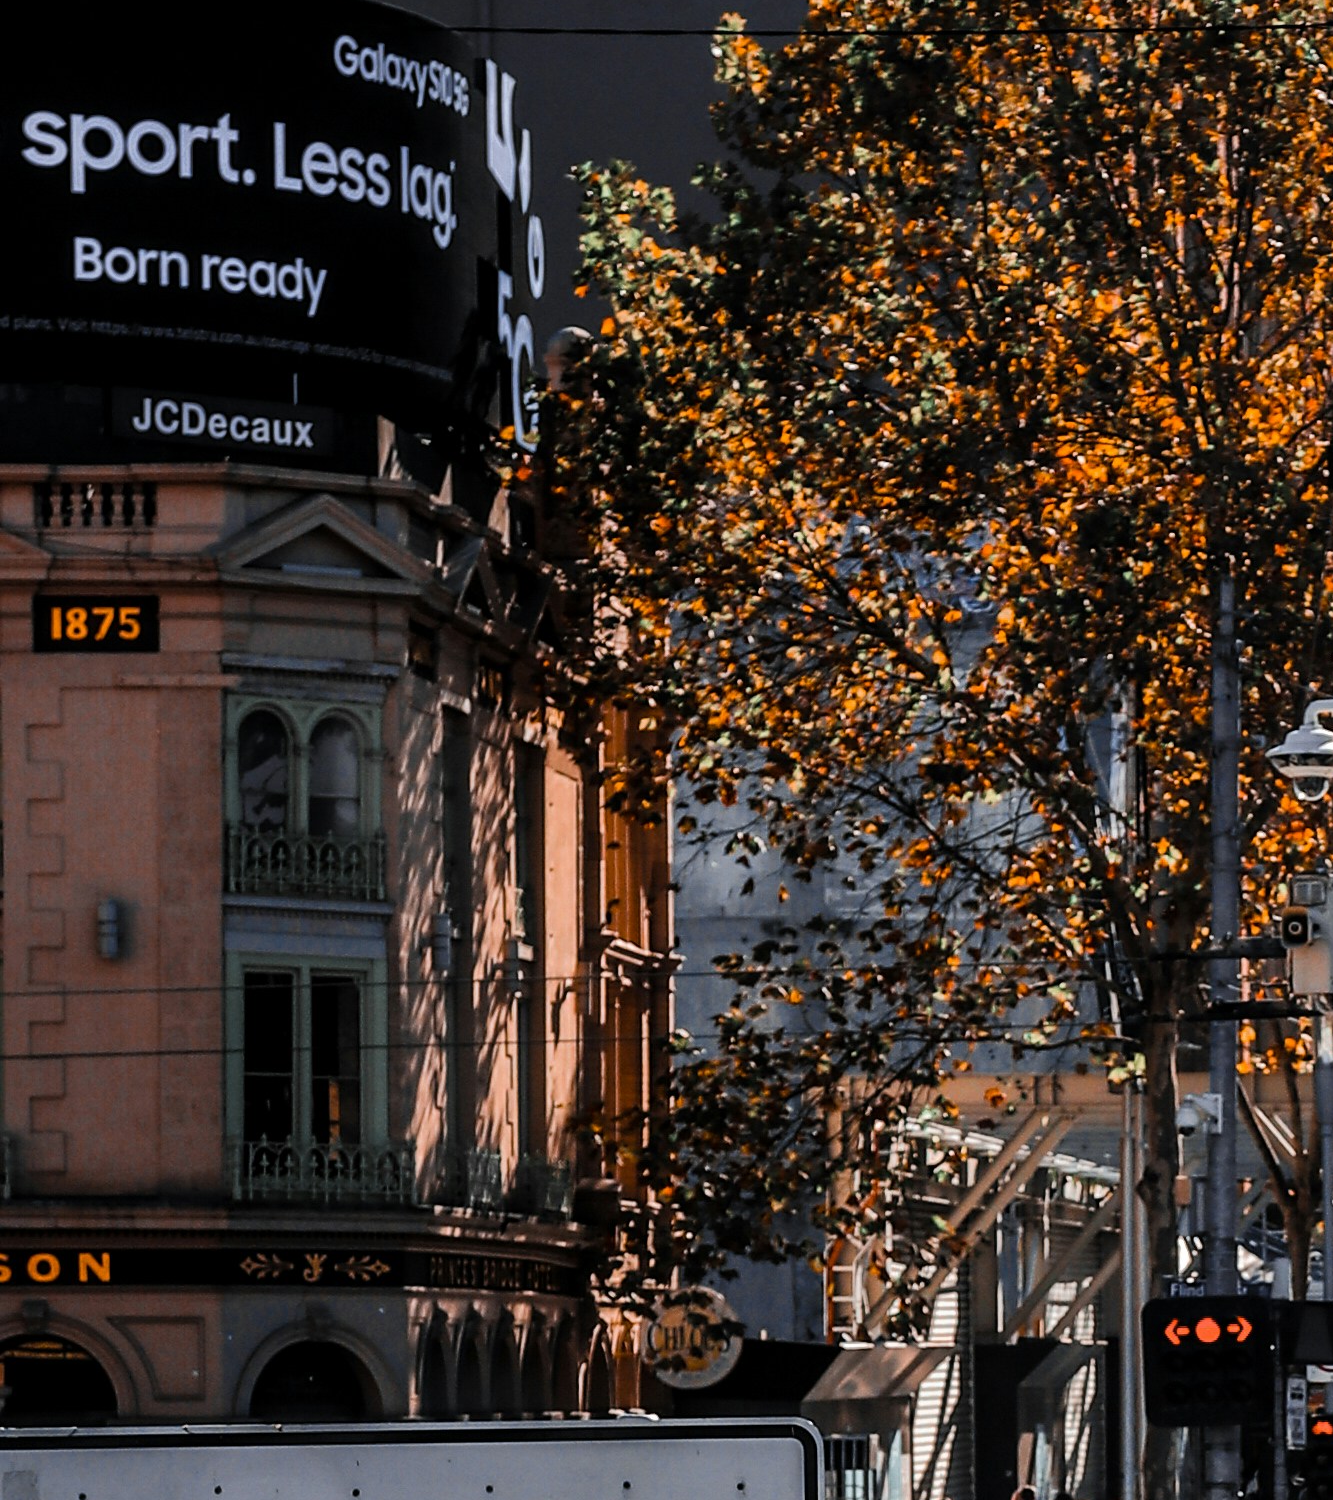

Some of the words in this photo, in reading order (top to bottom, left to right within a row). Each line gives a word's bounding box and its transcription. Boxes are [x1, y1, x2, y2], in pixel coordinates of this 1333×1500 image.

[334, 35, 430, 109] Galaxy
[21, 110, 257, 194] sport.
[273, 121, 392, 208] Less
[73, 237, 190, 289] Born
[202, 252, 328, 318] ready
[132, 398, 314, 449] JCDecaux
[50, 606, 142, 641] 1875
